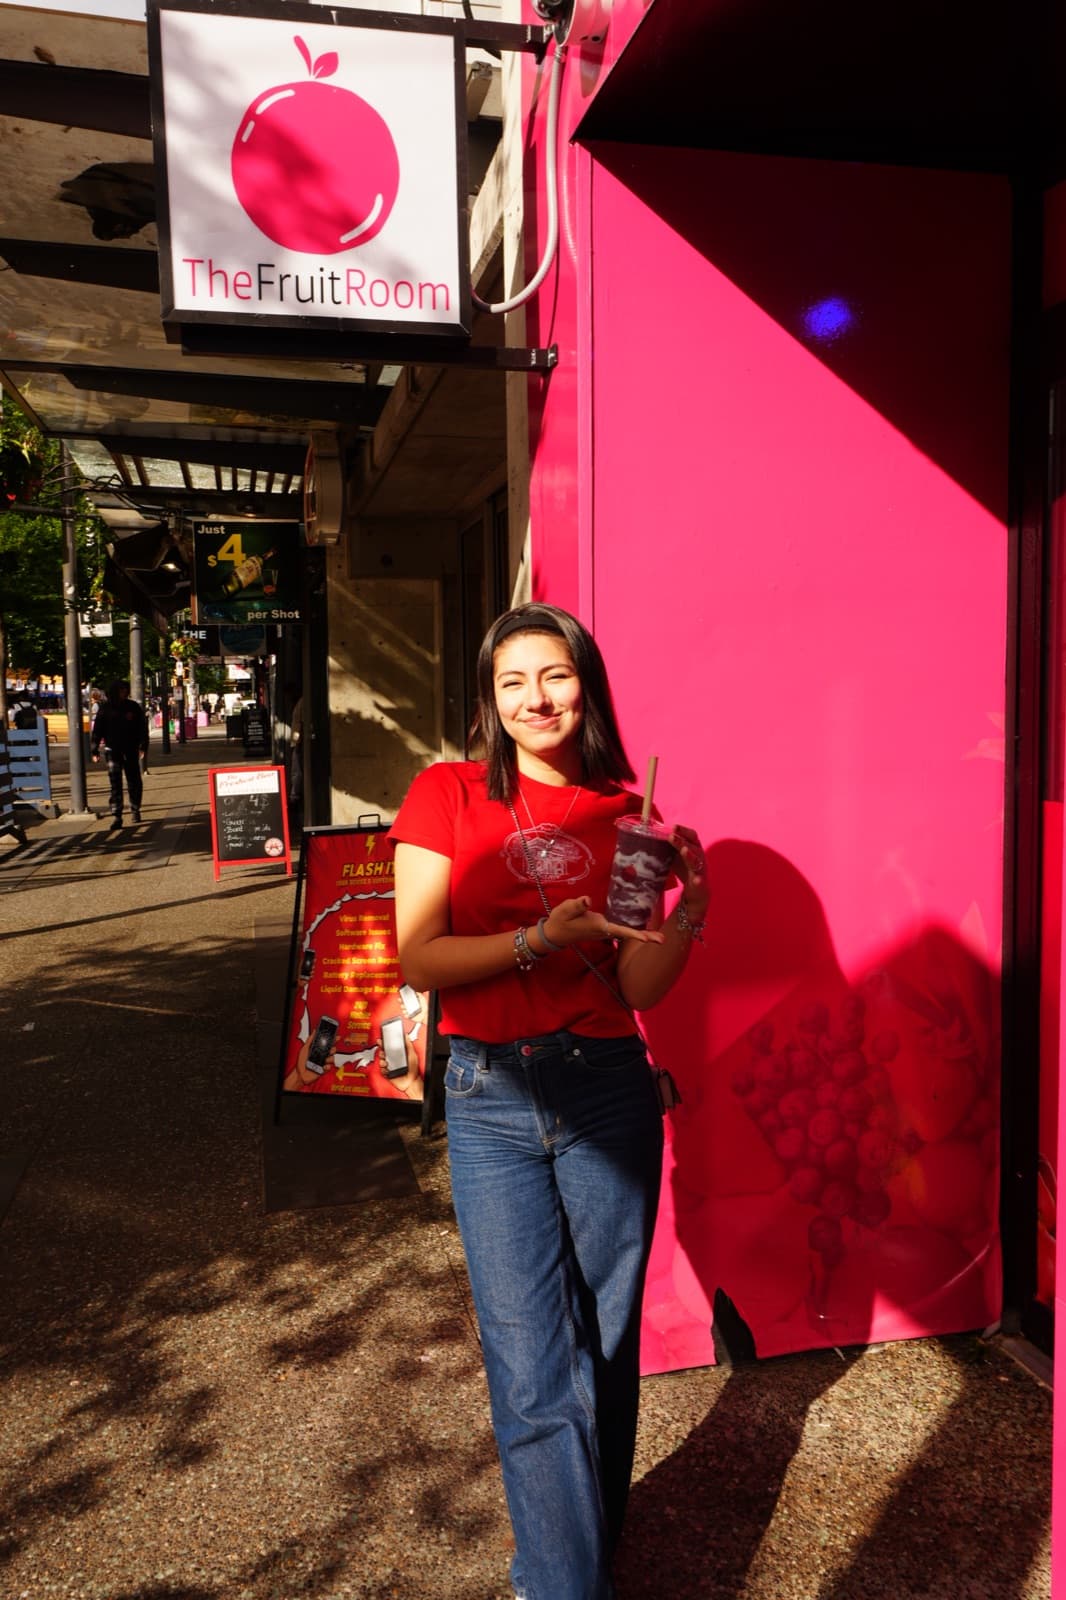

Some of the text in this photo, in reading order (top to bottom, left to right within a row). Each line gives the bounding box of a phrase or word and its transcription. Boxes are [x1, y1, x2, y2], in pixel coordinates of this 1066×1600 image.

[182, 258, 450, 311] TheFruitRoom
[198, 525, 226, 534] Just
[247, 609, 300, 621] per Shot
[342, 862, 385, 877] FLASH
[358, 913, 390, 921] Removal
[335, 929, 367, 937] Software
[339, 943, 373, 951] Hardware
[320, 985, 343, 994] Liquid
[343, 986, 373, 995] Damage
